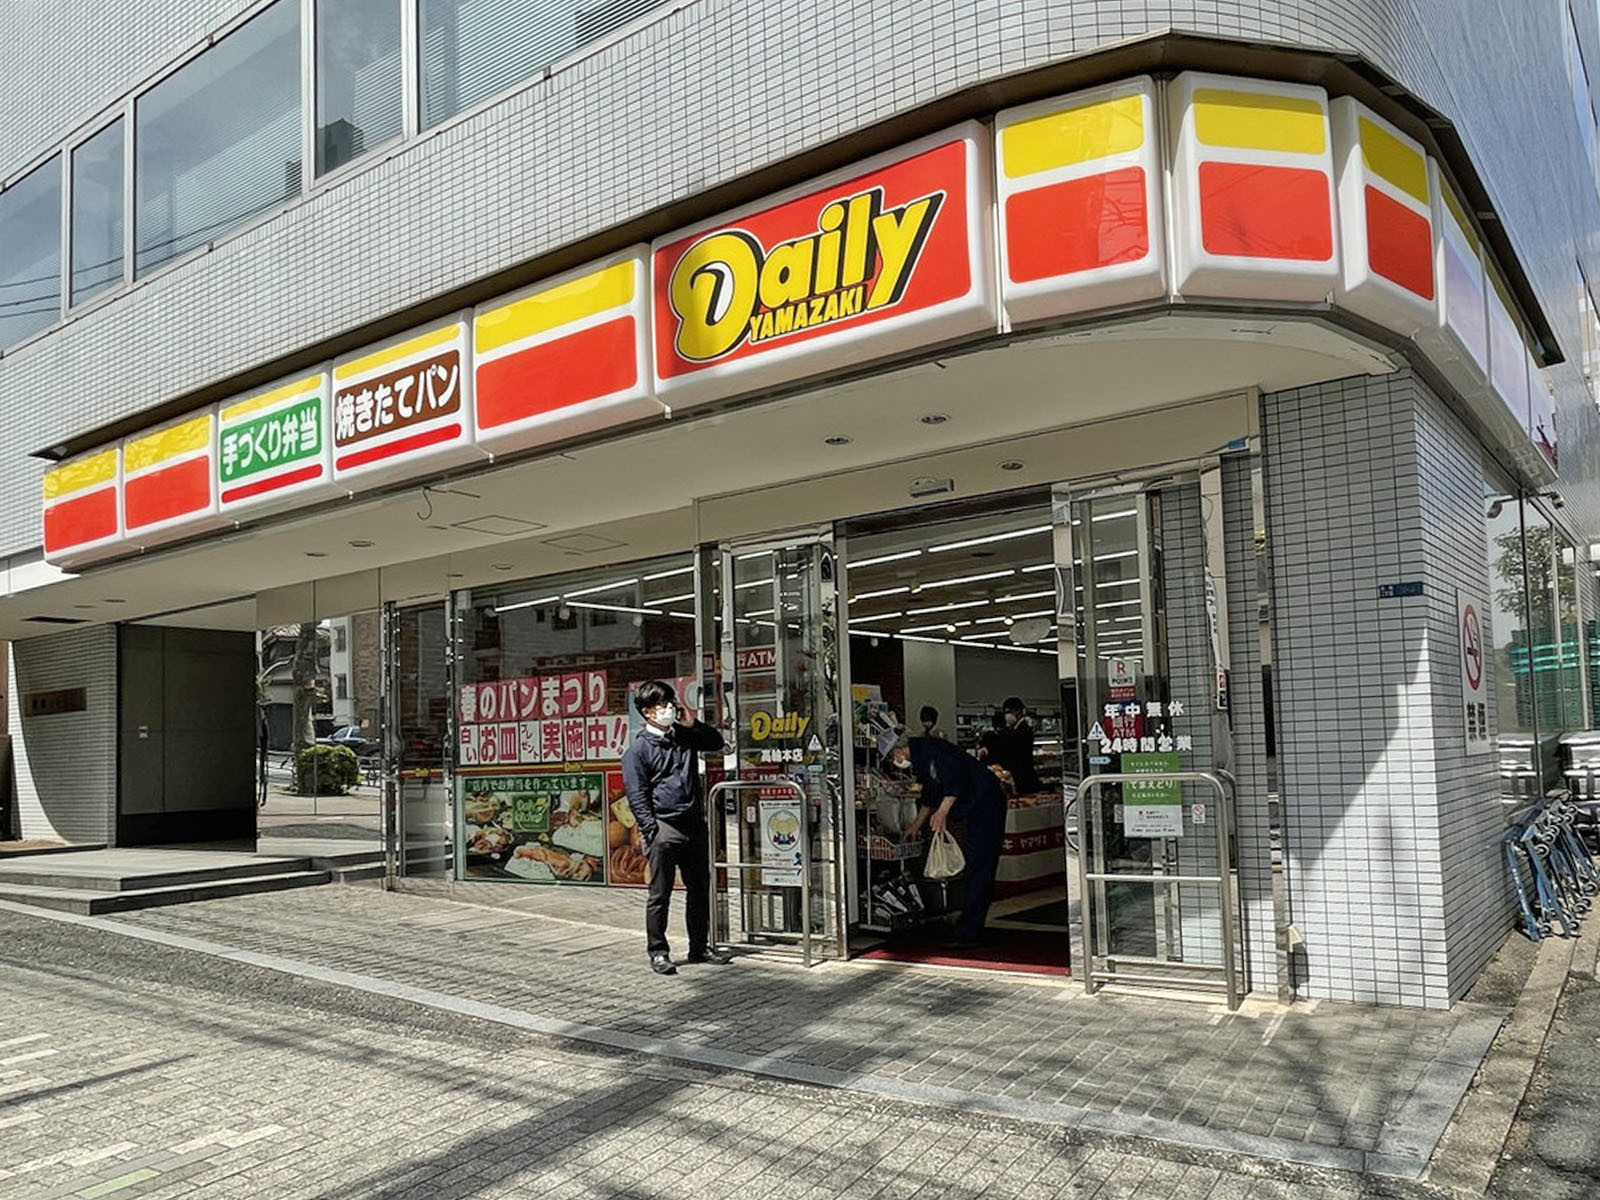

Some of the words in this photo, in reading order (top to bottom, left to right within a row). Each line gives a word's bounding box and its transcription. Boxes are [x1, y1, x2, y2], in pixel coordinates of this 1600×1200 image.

[670, 186, 946, 362] Daily
[750, 284, 867, 343] YAMAZAKI
[335, 363, 458, 441] 焼きたてパン
[222, 404, 319, 477] 手づくり弁当
[460, 673, 606, 722] 春のパンまつり
[1104, 700, 1184, 718] 年中無休
[751, 711, 810, 740] Daily
[1100, 733, 1192, 754] 24時間営業
